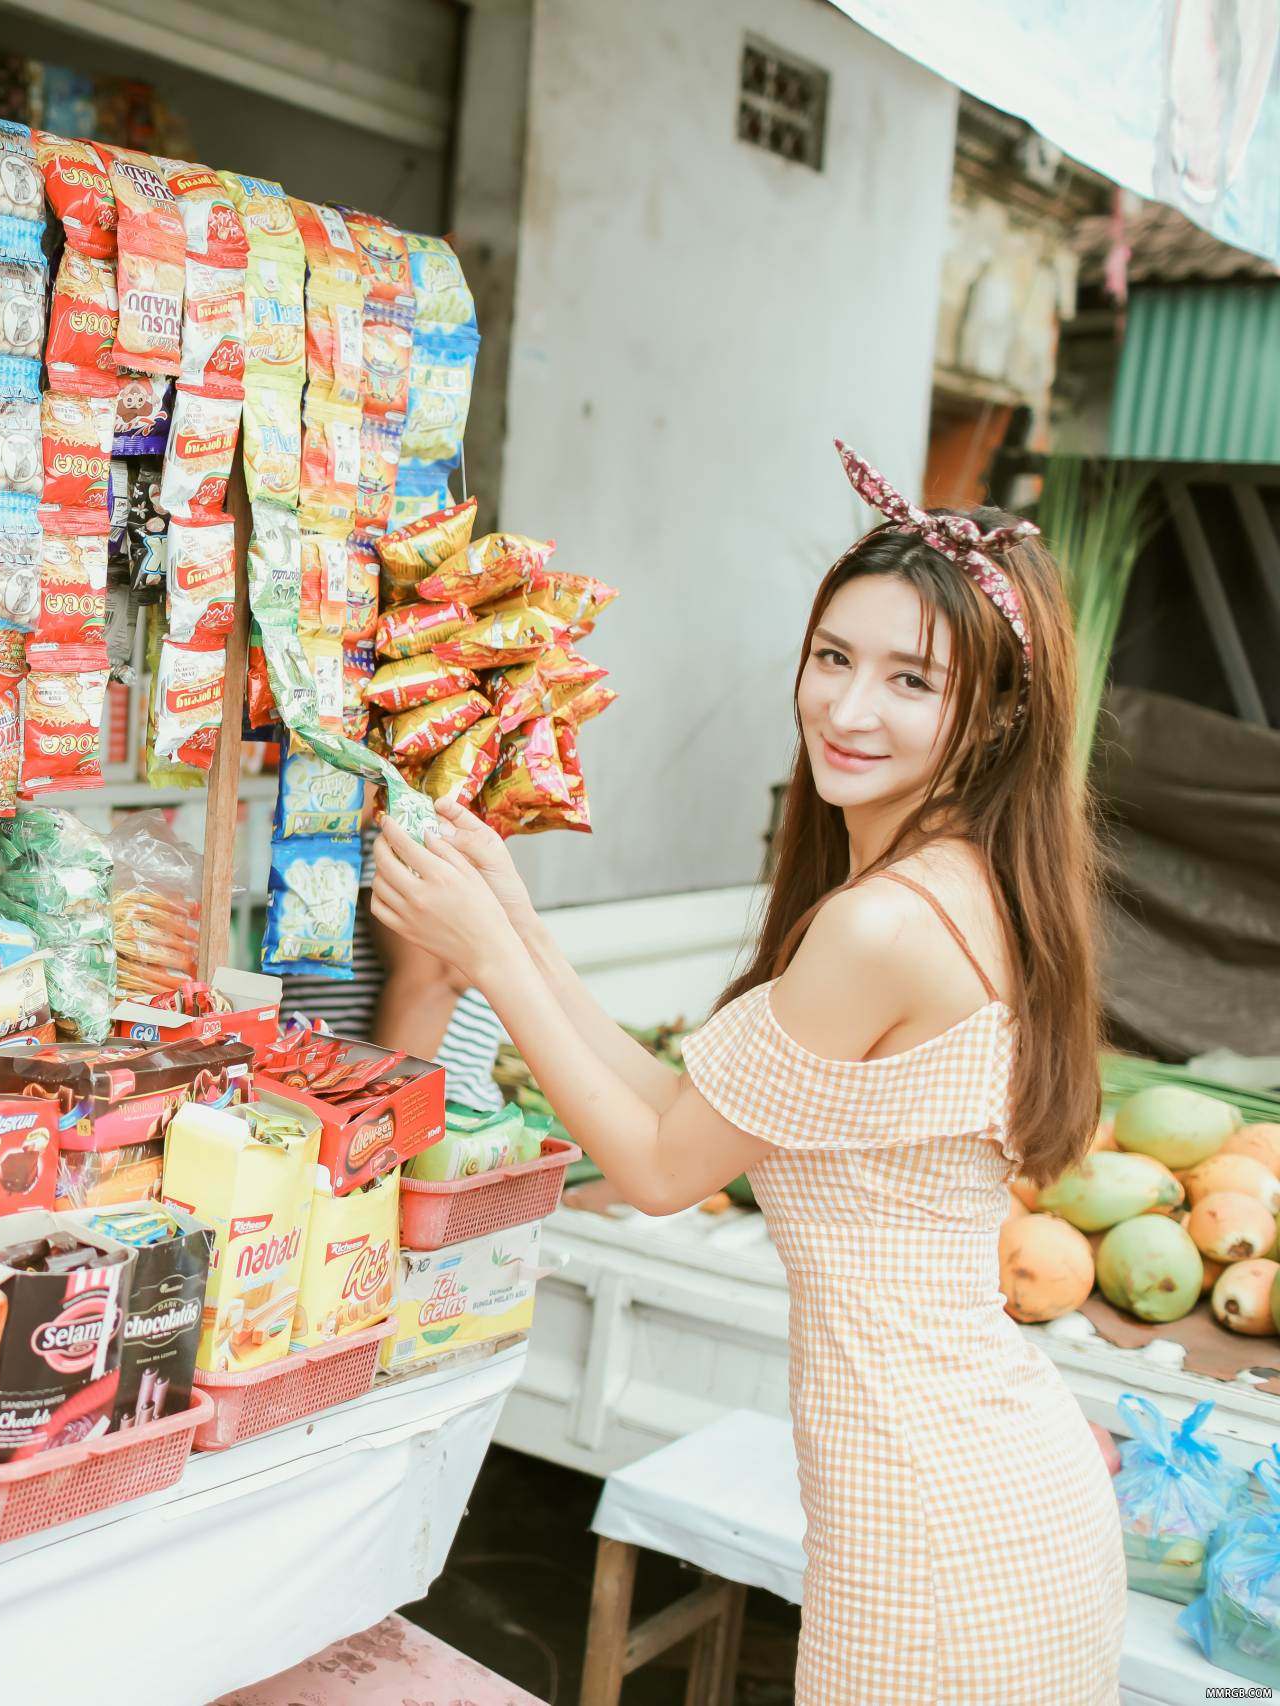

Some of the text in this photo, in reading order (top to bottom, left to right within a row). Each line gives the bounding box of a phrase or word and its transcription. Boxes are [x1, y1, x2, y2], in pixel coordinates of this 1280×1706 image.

[114, 161, 162, 187] MADU
[132, 180, 176, 202] SUSU
[127, 292, 178, 314] MADU
[140, 314, 181, 336] SUSU
[176, 692, 211, 709] goreng
[237, 1226, 303, 1279] nabati
[158, 1301, 177, 1311] DARK
[417, 1295, 468, 1327] Gelas
